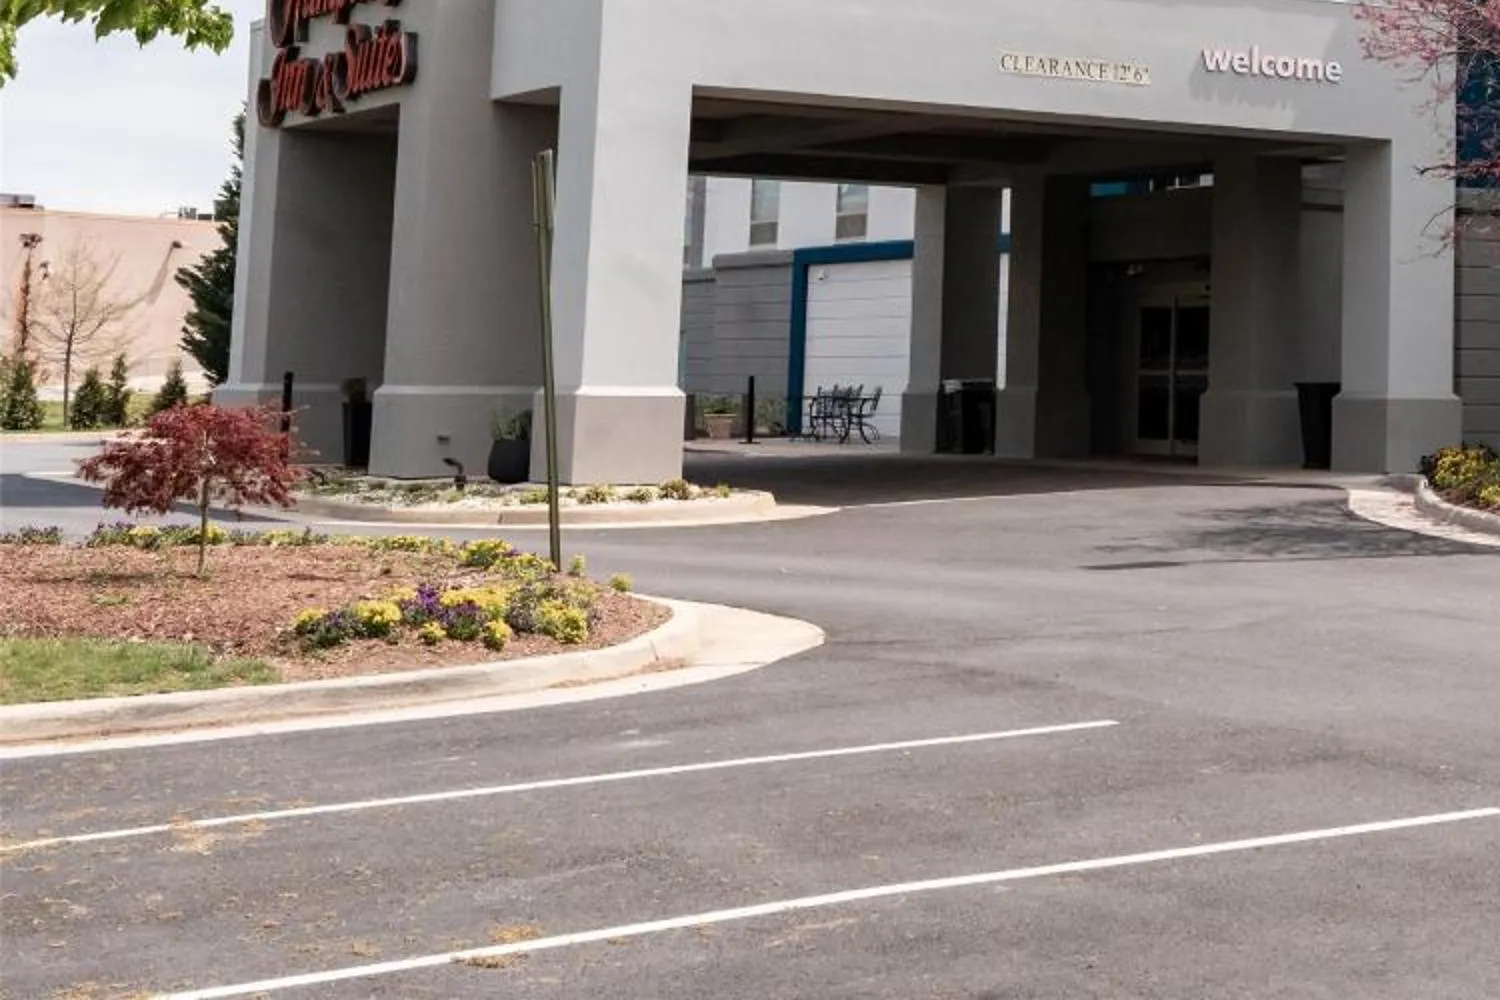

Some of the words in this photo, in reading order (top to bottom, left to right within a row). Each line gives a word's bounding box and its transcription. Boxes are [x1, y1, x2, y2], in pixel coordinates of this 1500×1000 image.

[257, 46, 320, 128] Inn
[332, 19, 418, 100] Suites
[1001, 54, 1109, 79] CLEARANCE
[1202, 46, 1342, 82] welcome
